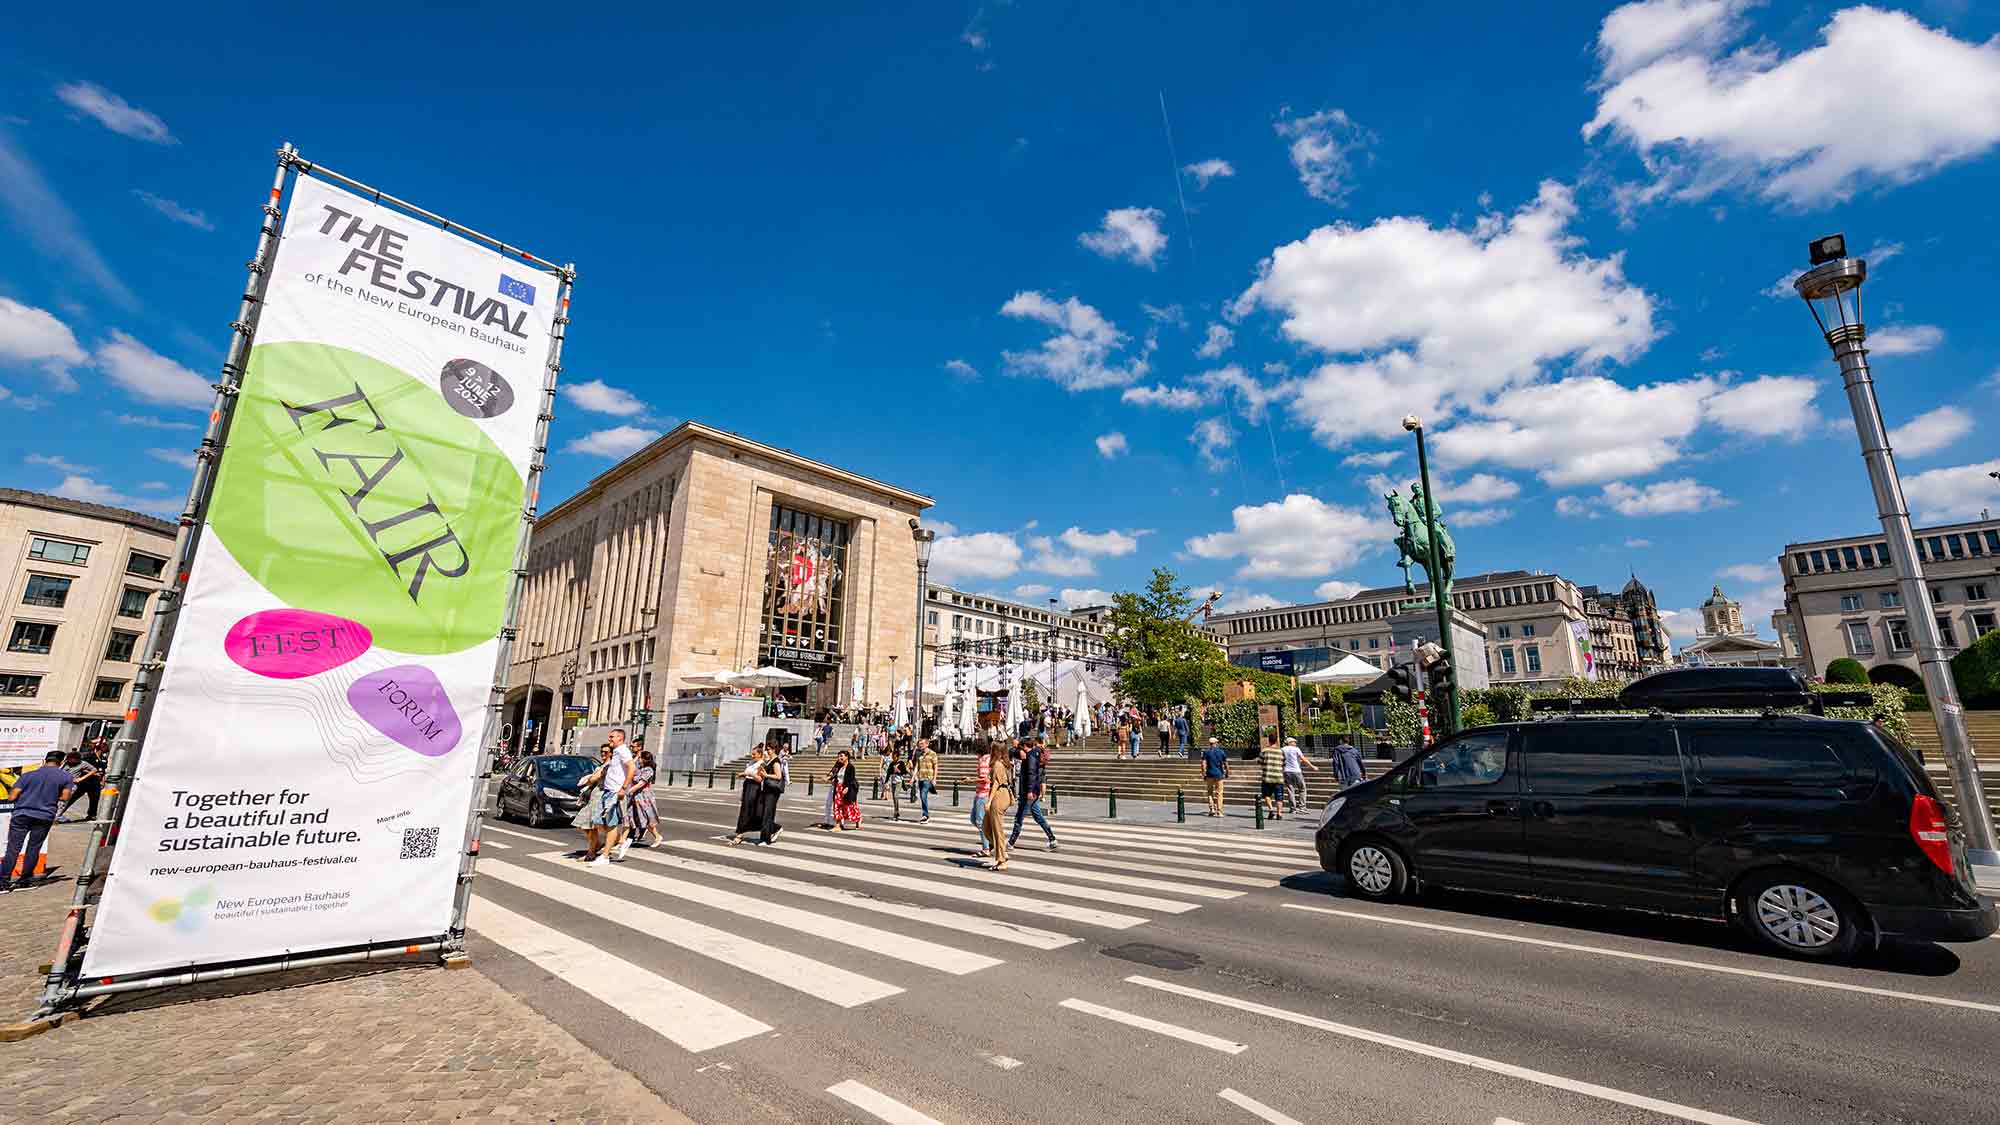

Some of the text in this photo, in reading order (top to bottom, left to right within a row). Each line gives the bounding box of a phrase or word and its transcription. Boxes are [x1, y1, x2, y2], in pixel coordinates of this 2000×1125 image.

[320, 204, 409, 263] THE
[338, 248, 529, 340] FESTIVAL
[304, 273, 527, 354] of the New European Bauhaus
[460, 376, 492, 402] JUNE
[465, 367, 477, 377] 9
[486, 382, 501, 397] 12
[453, 384, 485, 409] 2022
[279, 380, 471, 606] FAIR
[250, 627, 346, 658] FEST
[378, 679, 444, 741] FORUM
[171, 789, 310, 811] Together for
[164, 808, 330, 830] a beautiful and
[158, 829, 361, 852] sustainable future.
[150, 855, 358, 876] new-european-bauhaus-festival.eu
[214, 909, 255, 920] beautiful
[261, 905, 309, 915] sustainable
[314, 901, 349, 911] together
[217, 889, 351, 910] New European Bauhaus
